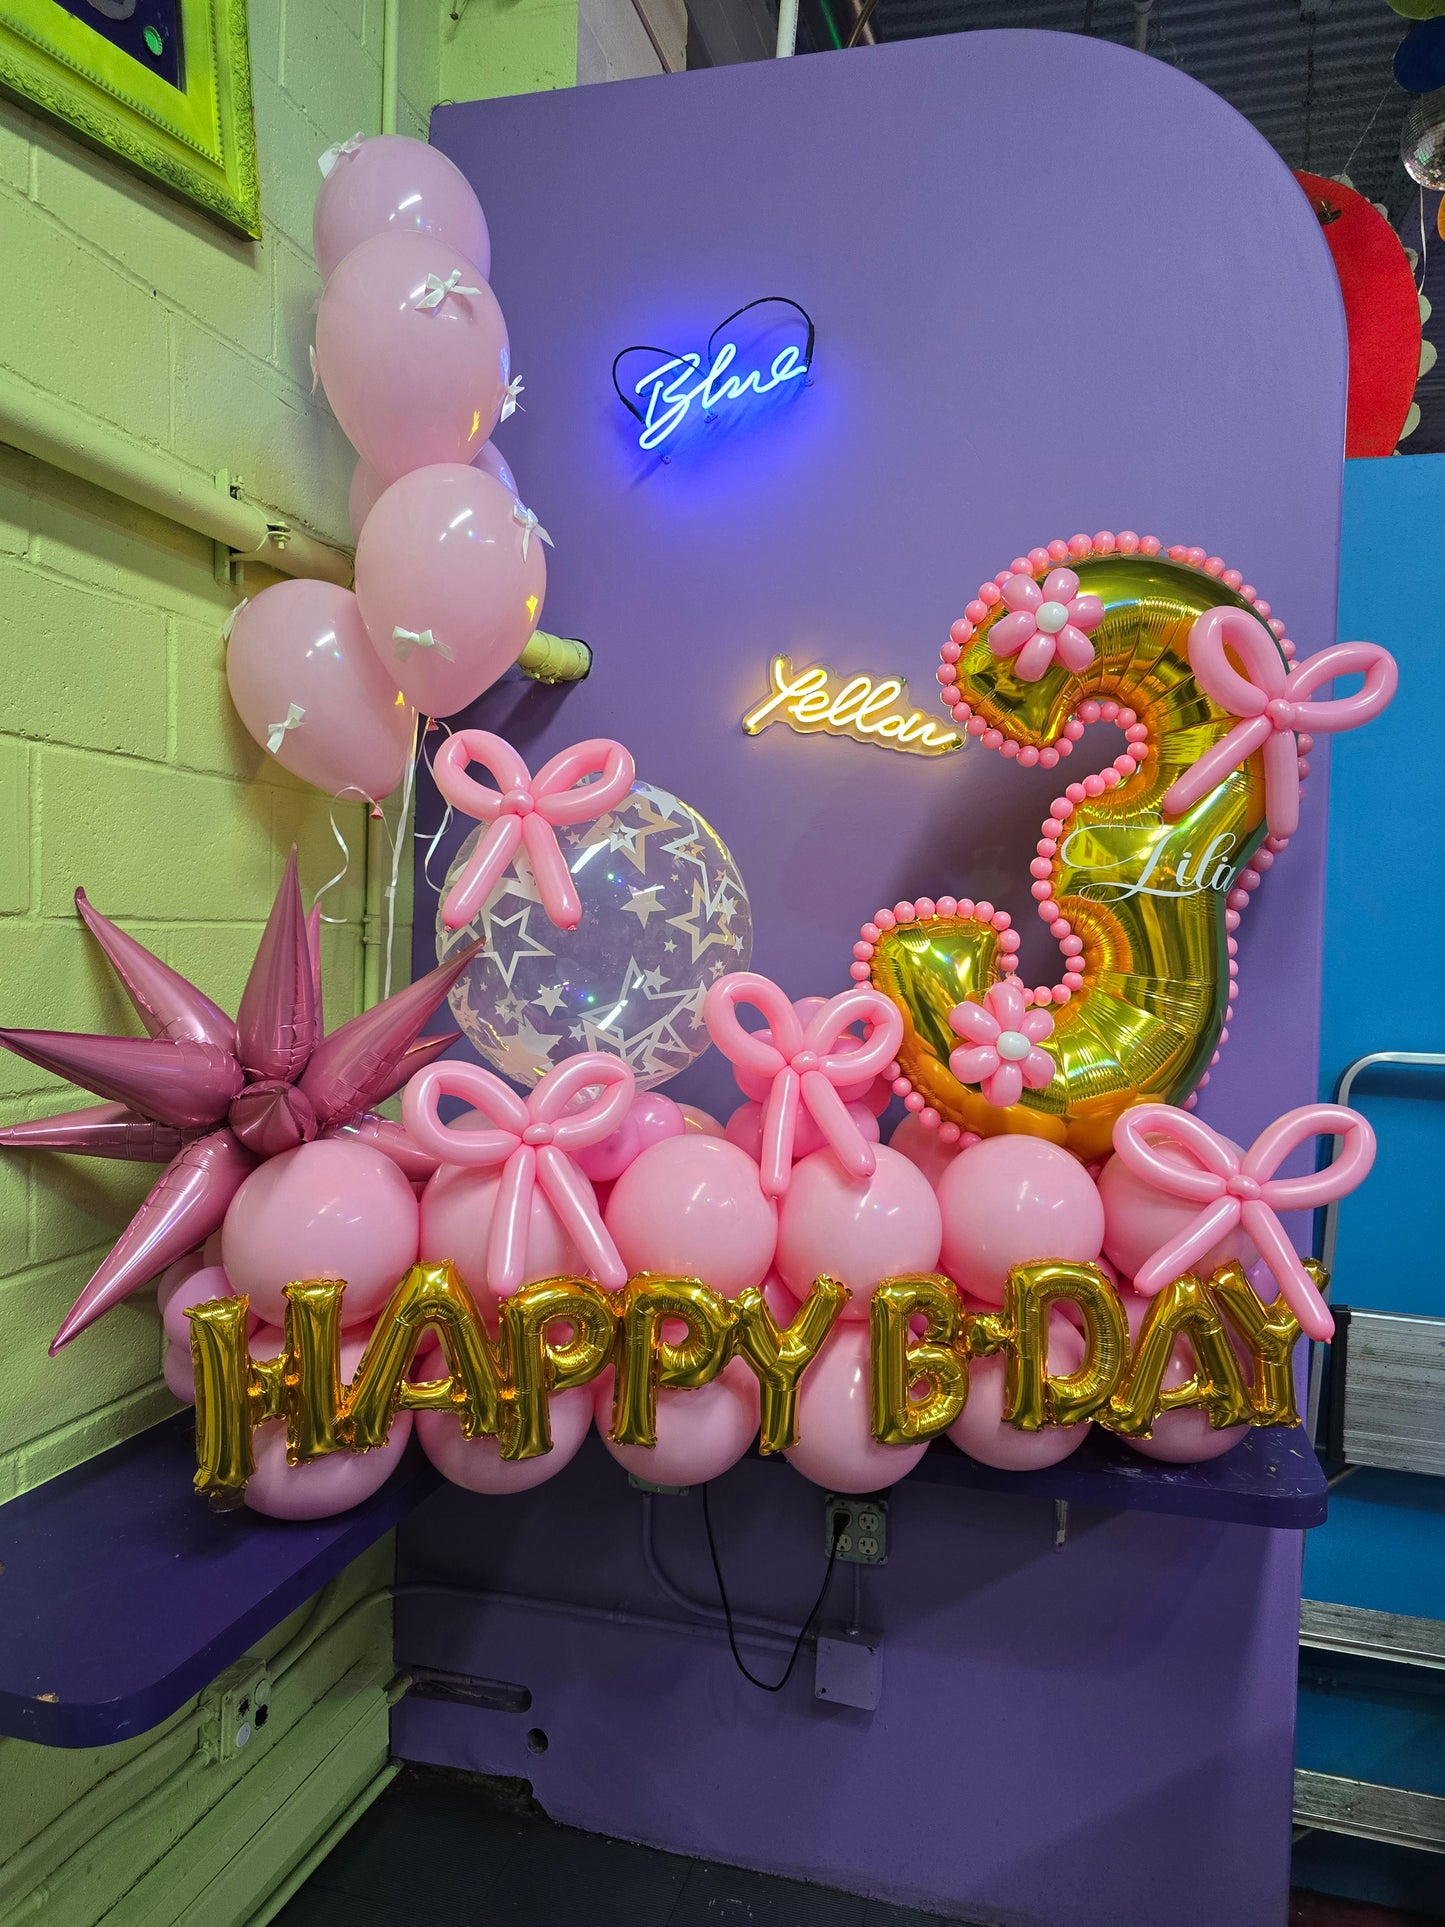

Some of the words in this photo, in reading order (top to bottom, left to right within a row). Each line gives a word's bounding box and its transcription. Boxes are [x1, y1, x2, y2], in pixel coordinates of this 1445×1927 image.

[635, 342, 808, 451] Blue
[746, 657, 959, 747] Yellow
[872, 552, 1288, 1152] 3
[181, 1258, 853, 1512] HAPPY
